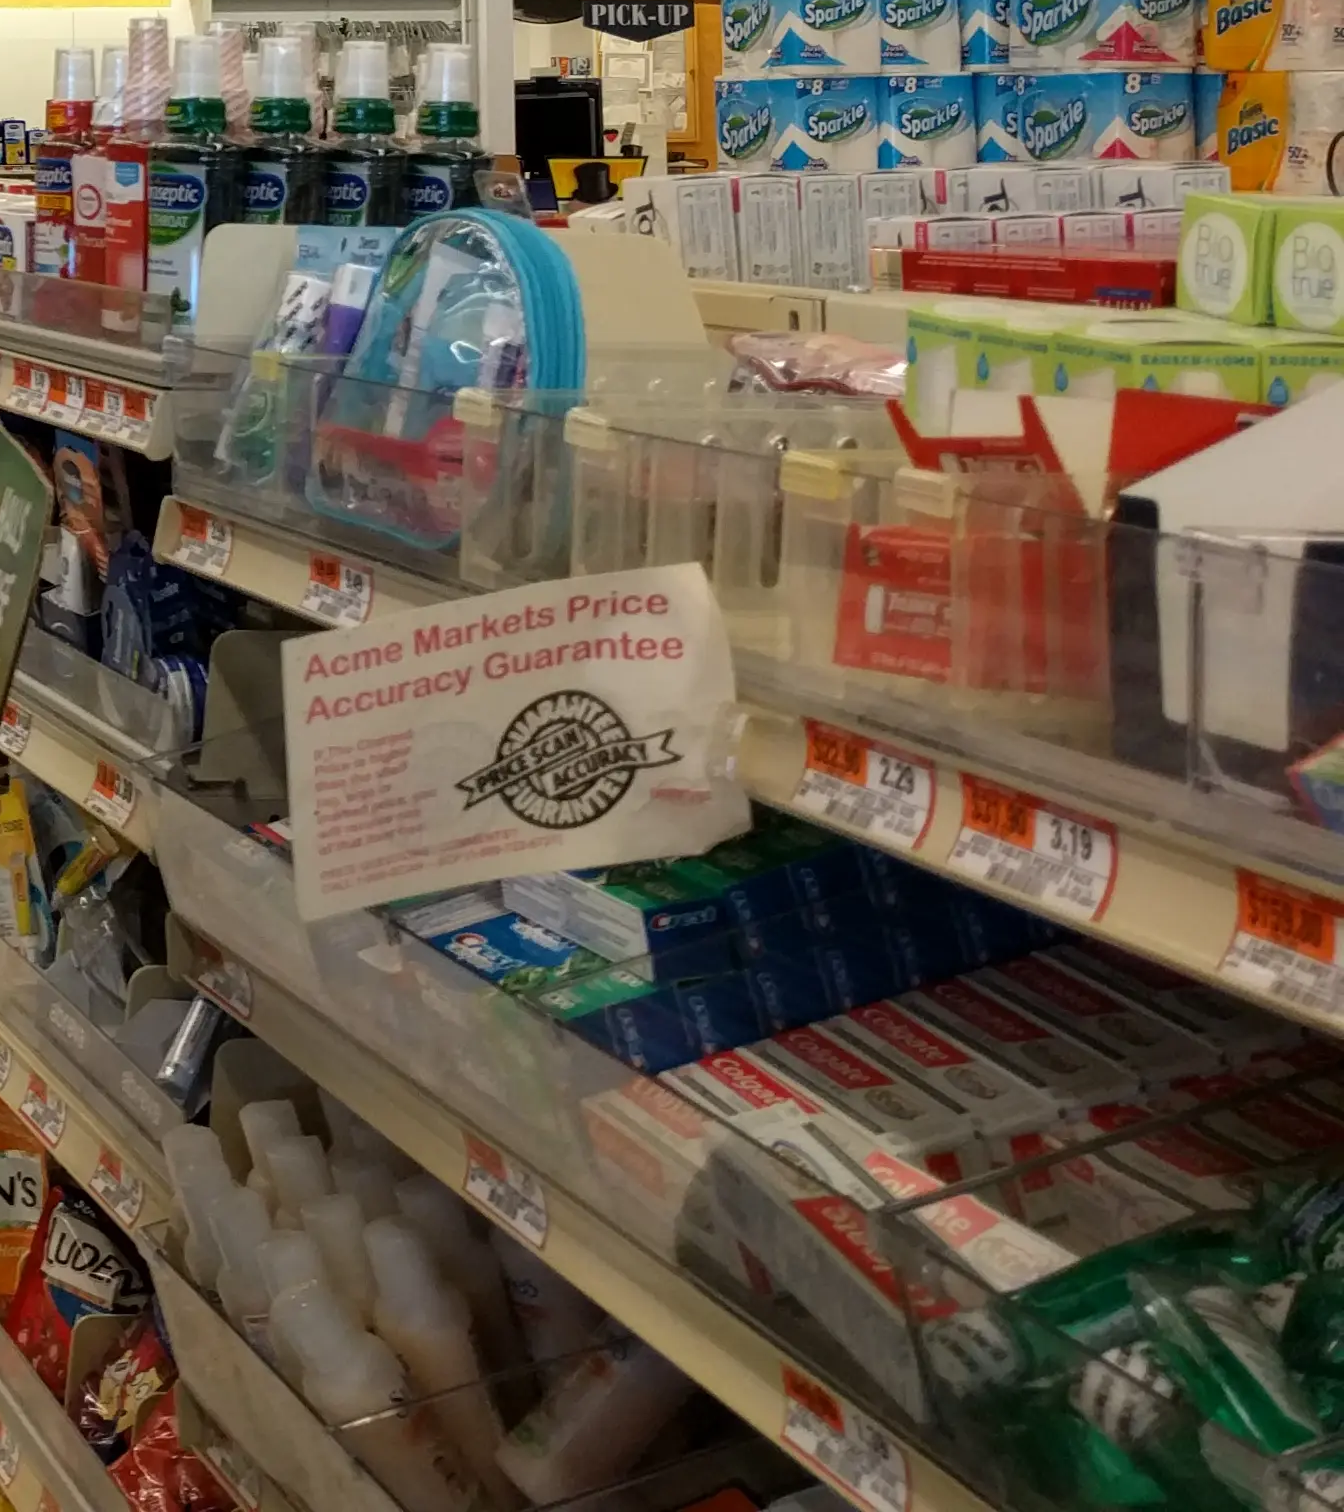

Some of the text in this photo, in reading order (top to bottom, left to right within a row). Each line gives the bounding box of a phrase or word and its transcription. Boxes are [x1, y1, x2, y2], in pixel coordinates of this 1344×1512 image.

[591, 4, 689, 26] PICK-UP
[812, 79, 824, 96] 8
[904, 76, 917, 93] 8
[1126, 72, 1142, 93] 8
[722, 105, 771, 156] Sparkle
[808, 102, 865, 139] Sparkle
[900, 100, 959, 140] Sparkle
[1024, 99, 1084, 157] Sparkle
[1130, 101, 1187, 133] Sparkle
[1226, 113, 1279, 156] Basic
[304, 591, 669, 684] Acme Markets Price
[306, 632, 685, 724] Accuracy Guarantee
[476, 730, 580, 793] PRICE SCAN
[551, 741, 648, 789] ACCURACY
[1049, 818, 1093, 861] 3.19
[788, 1029, 872, 1086] Colgate
[860, 1006, 950, 1065] Colgate
[711, 1055, 788, 1107] Colgat
[46, 1215, 140, 1296] LUDEN
